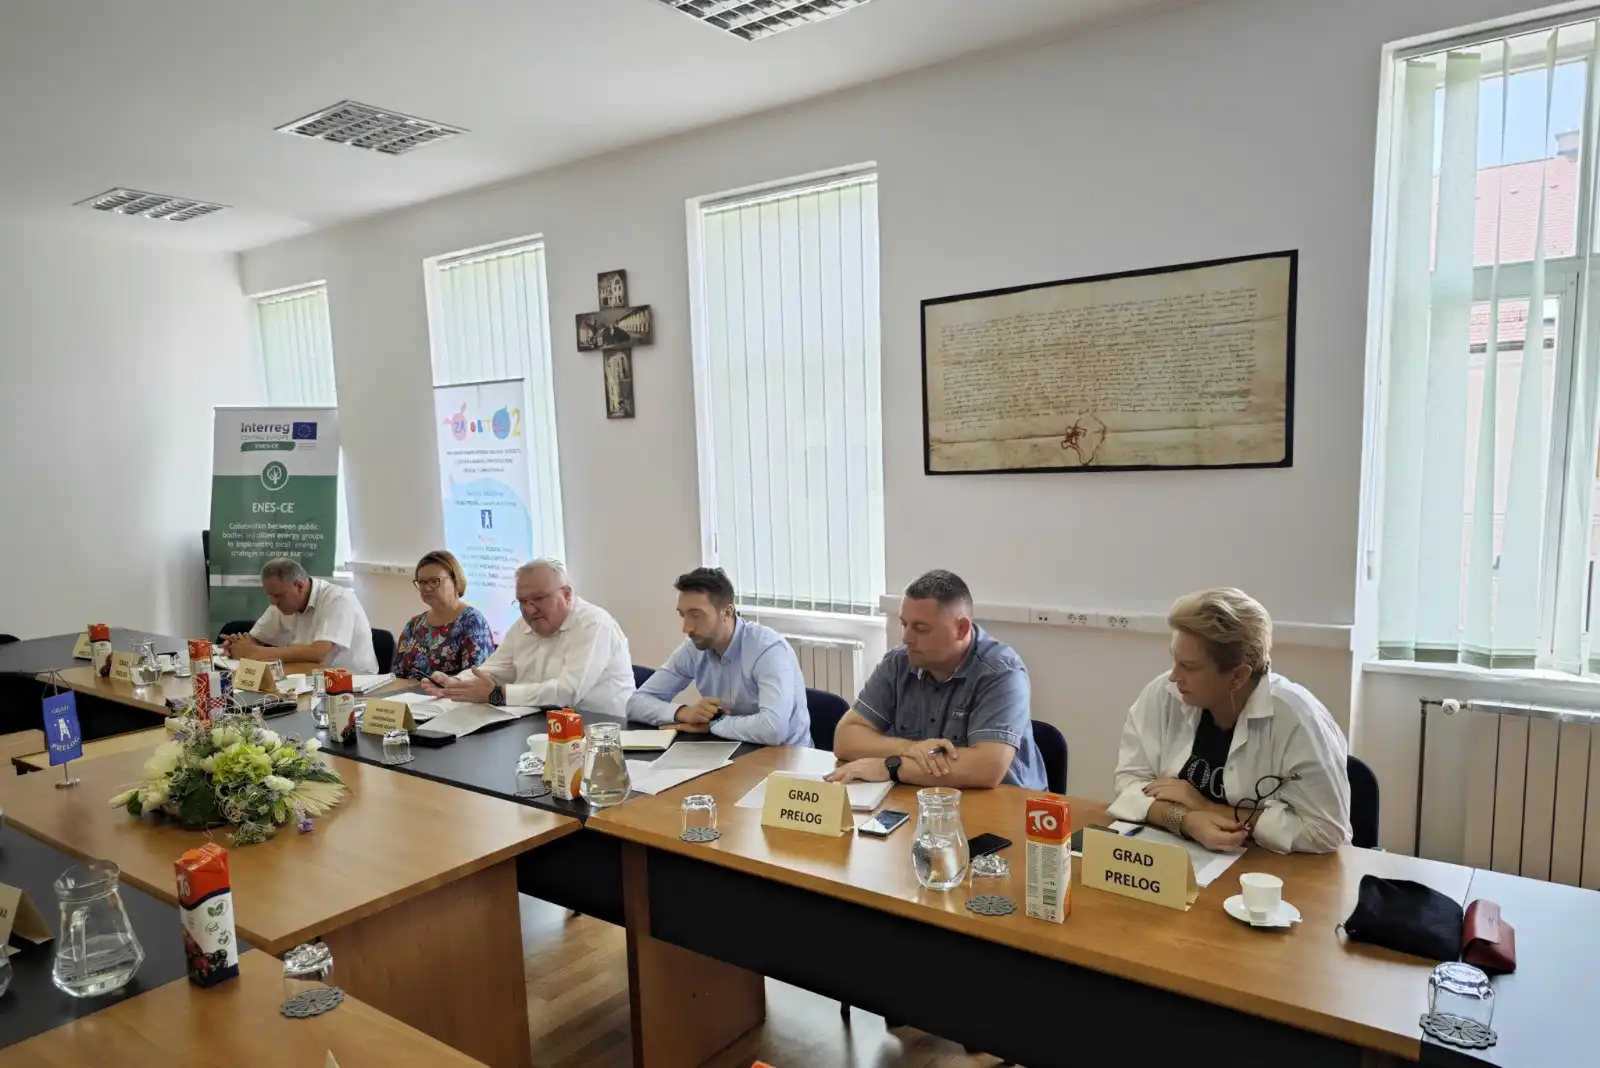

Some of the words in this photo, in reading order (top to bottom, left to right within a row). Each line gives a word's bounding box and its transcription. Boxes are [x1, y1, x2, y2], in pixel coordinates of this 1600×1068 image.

[240, 422, 290, 434] Interreg
[252, 502, 295, 513] ENES-CE
[788, 789, 819, 803] GRAD
[780, 808, 822, 825] PRELOG
[1112, 847, 1154, 867] GRAD
[1105, 869, 1161, 893] PRELOG
